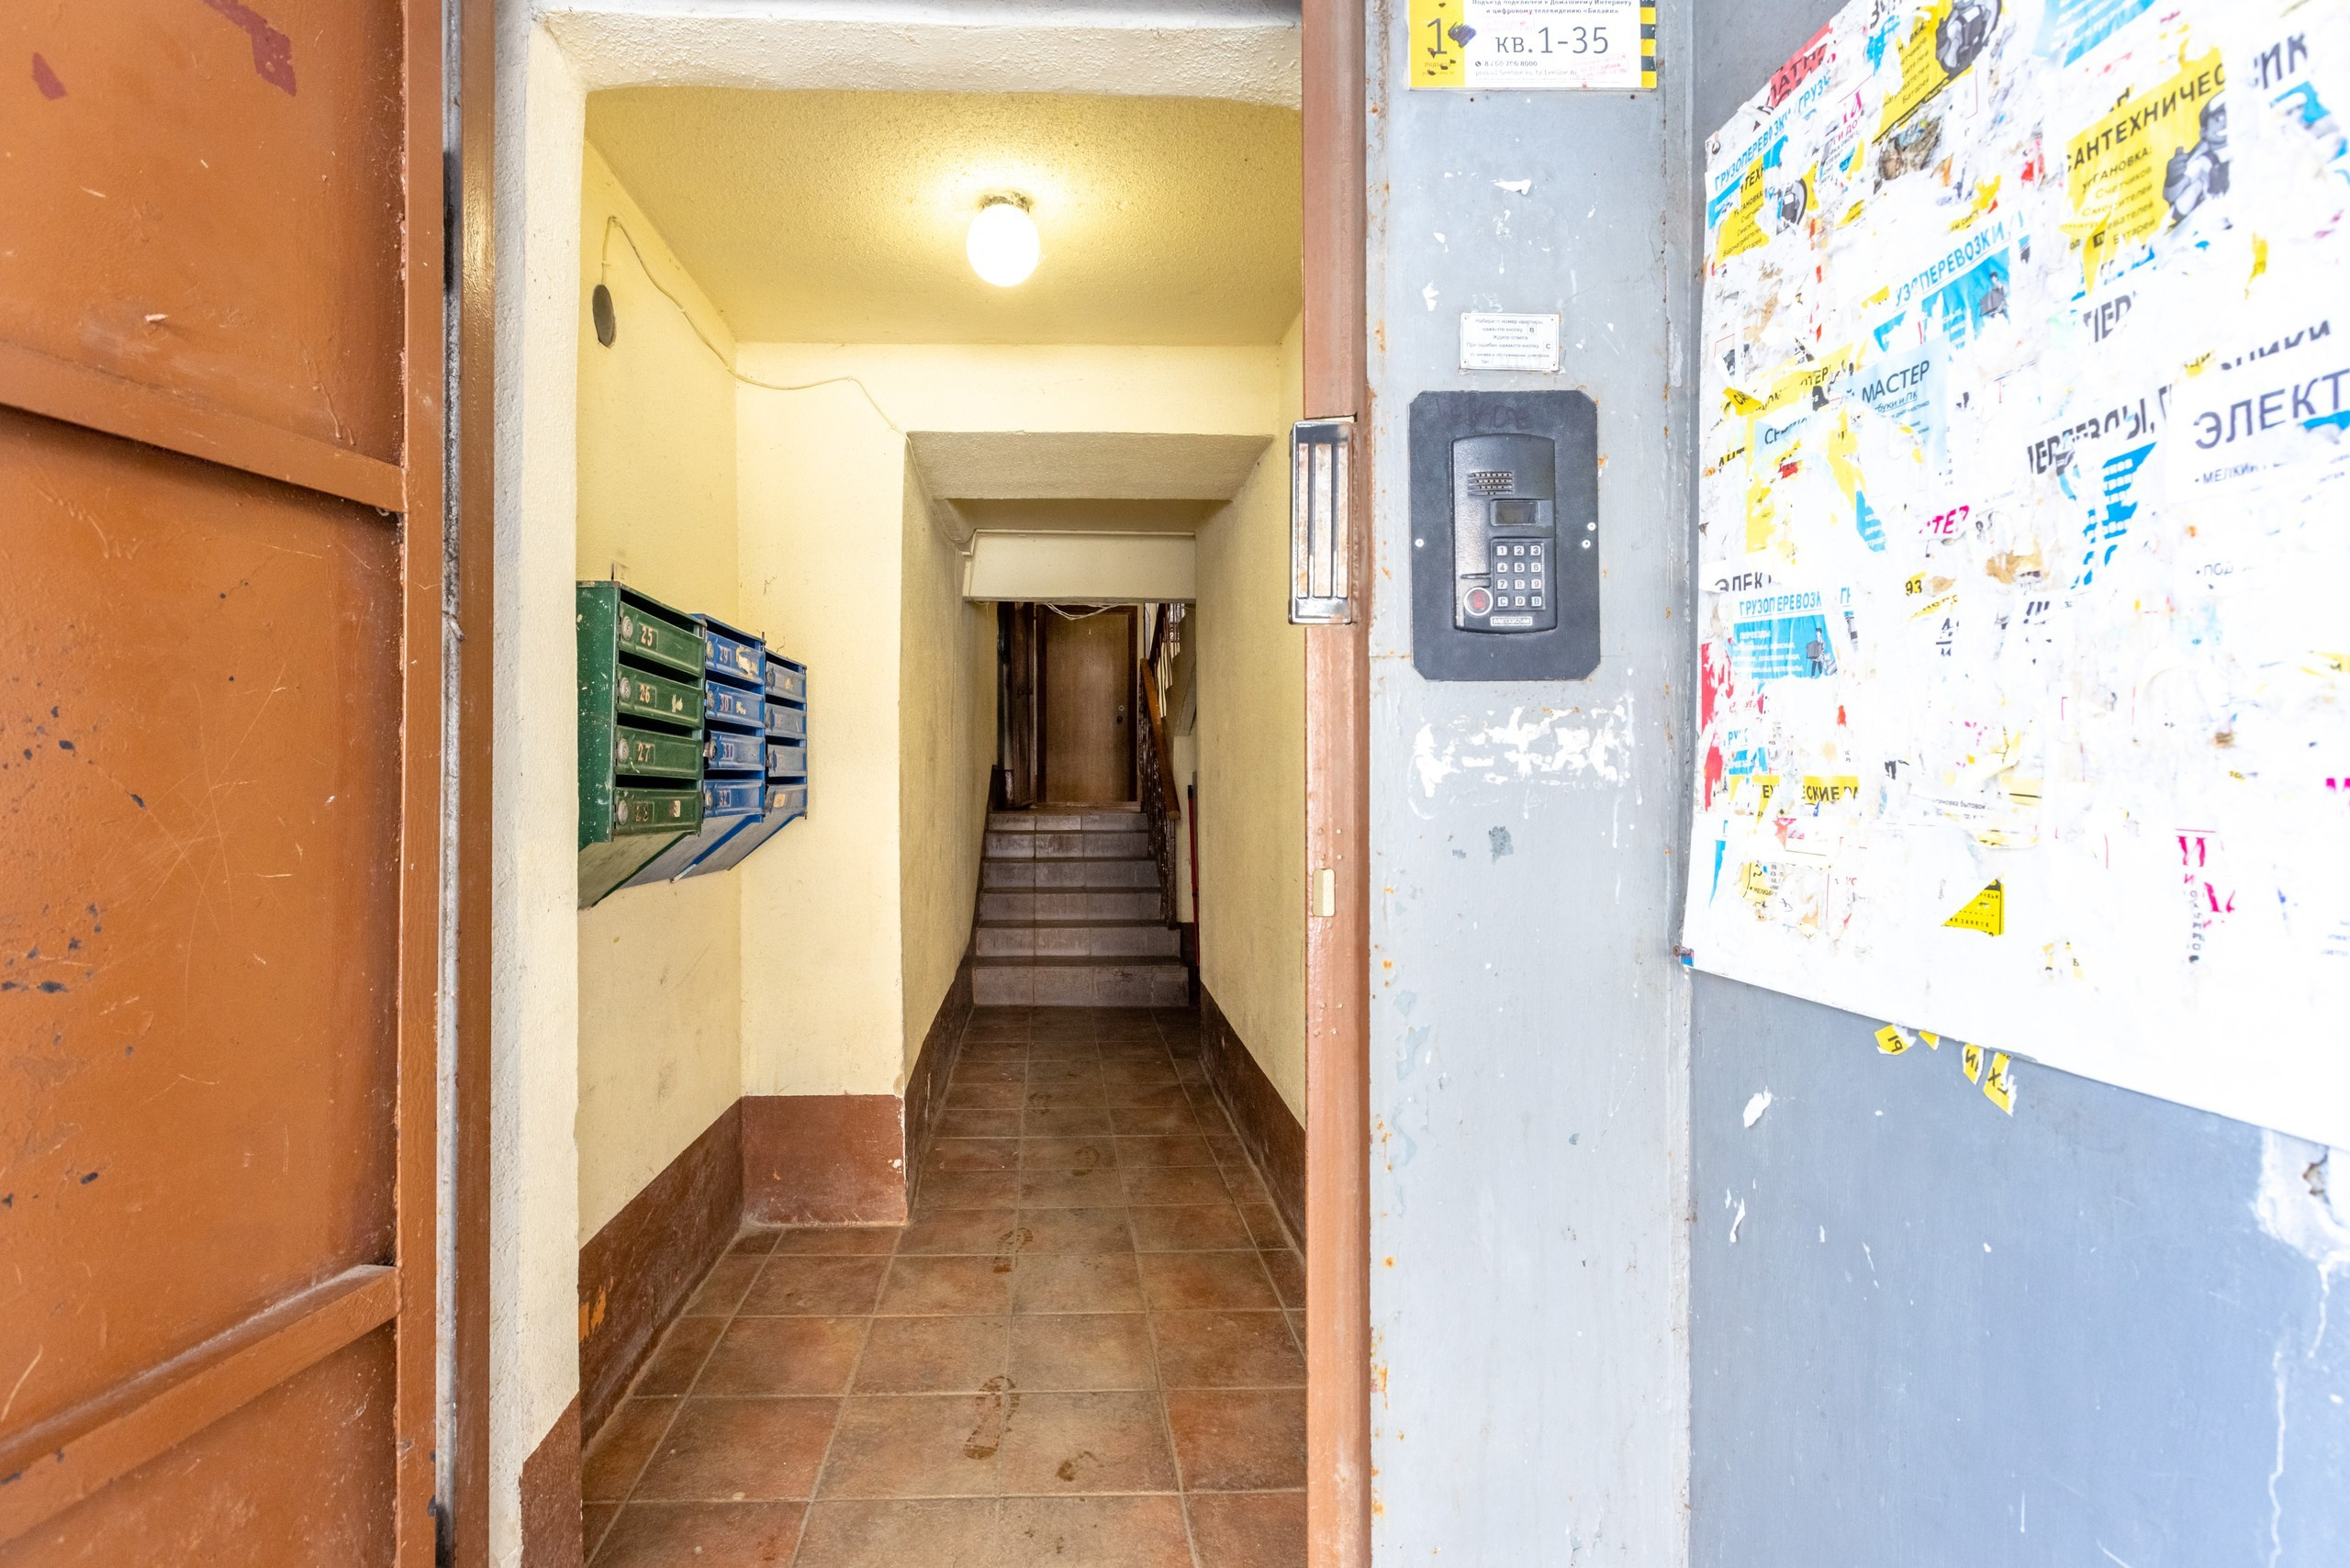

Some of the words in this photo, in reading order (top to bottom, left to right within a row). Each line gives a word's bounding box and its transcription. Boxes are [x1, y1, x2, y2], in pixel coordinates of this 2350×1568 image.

[1427, 18, 1448, 55] 1
[1495, 27, 1609, 54] кв.1-35
[2113, 218, 2156, 245] Бтарей
[1862, 360, 1930, 404] МАСТЕР
[2193, 368, 2350, 450] ЭЛЕКТ
[641, 627, 654, 647] 25
[719, 645, 730, 663] 29
[639, 683, 651, 703] 26
[720, 694, 731, 711] 30
[637, 742, 651, 762] 27
[719, 790, 729, 806] 32
